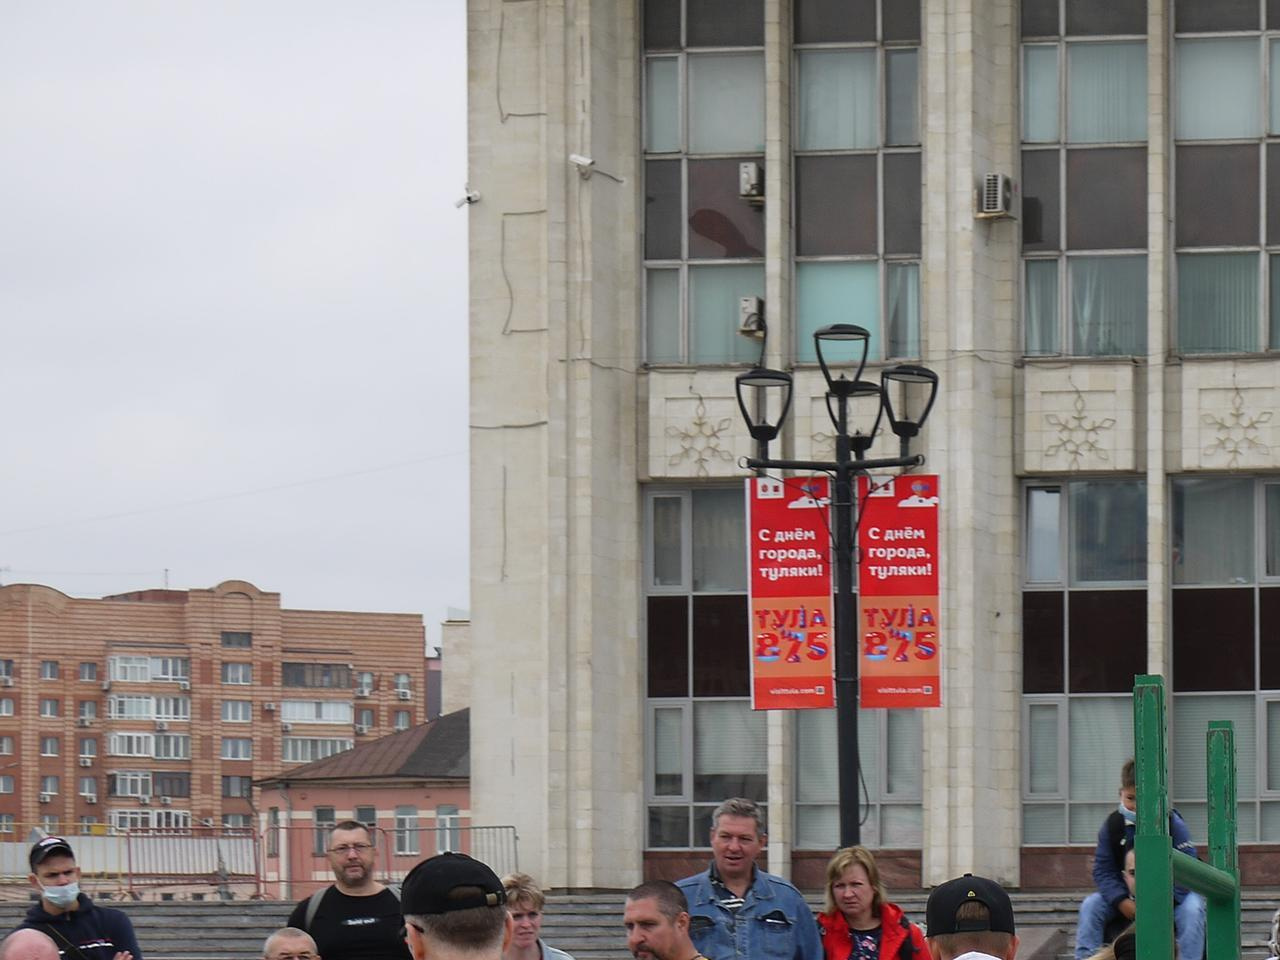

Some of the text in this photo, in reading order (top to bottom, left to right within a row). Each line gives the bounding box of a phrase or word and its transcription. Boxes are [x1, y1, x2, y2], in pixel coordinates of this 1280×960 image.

[758, 528, 816, 543] С днём
[868, 526, 926, 542] С днём
[759, 548, 821, 562] города,
[868, 547, 930, 561] города,
[759, 564, 823, 581] туляки!
[868, 563, 932, 580] туляки!
[755, 628, 828, 663] 875
[863, 628, 937, 662] 875
